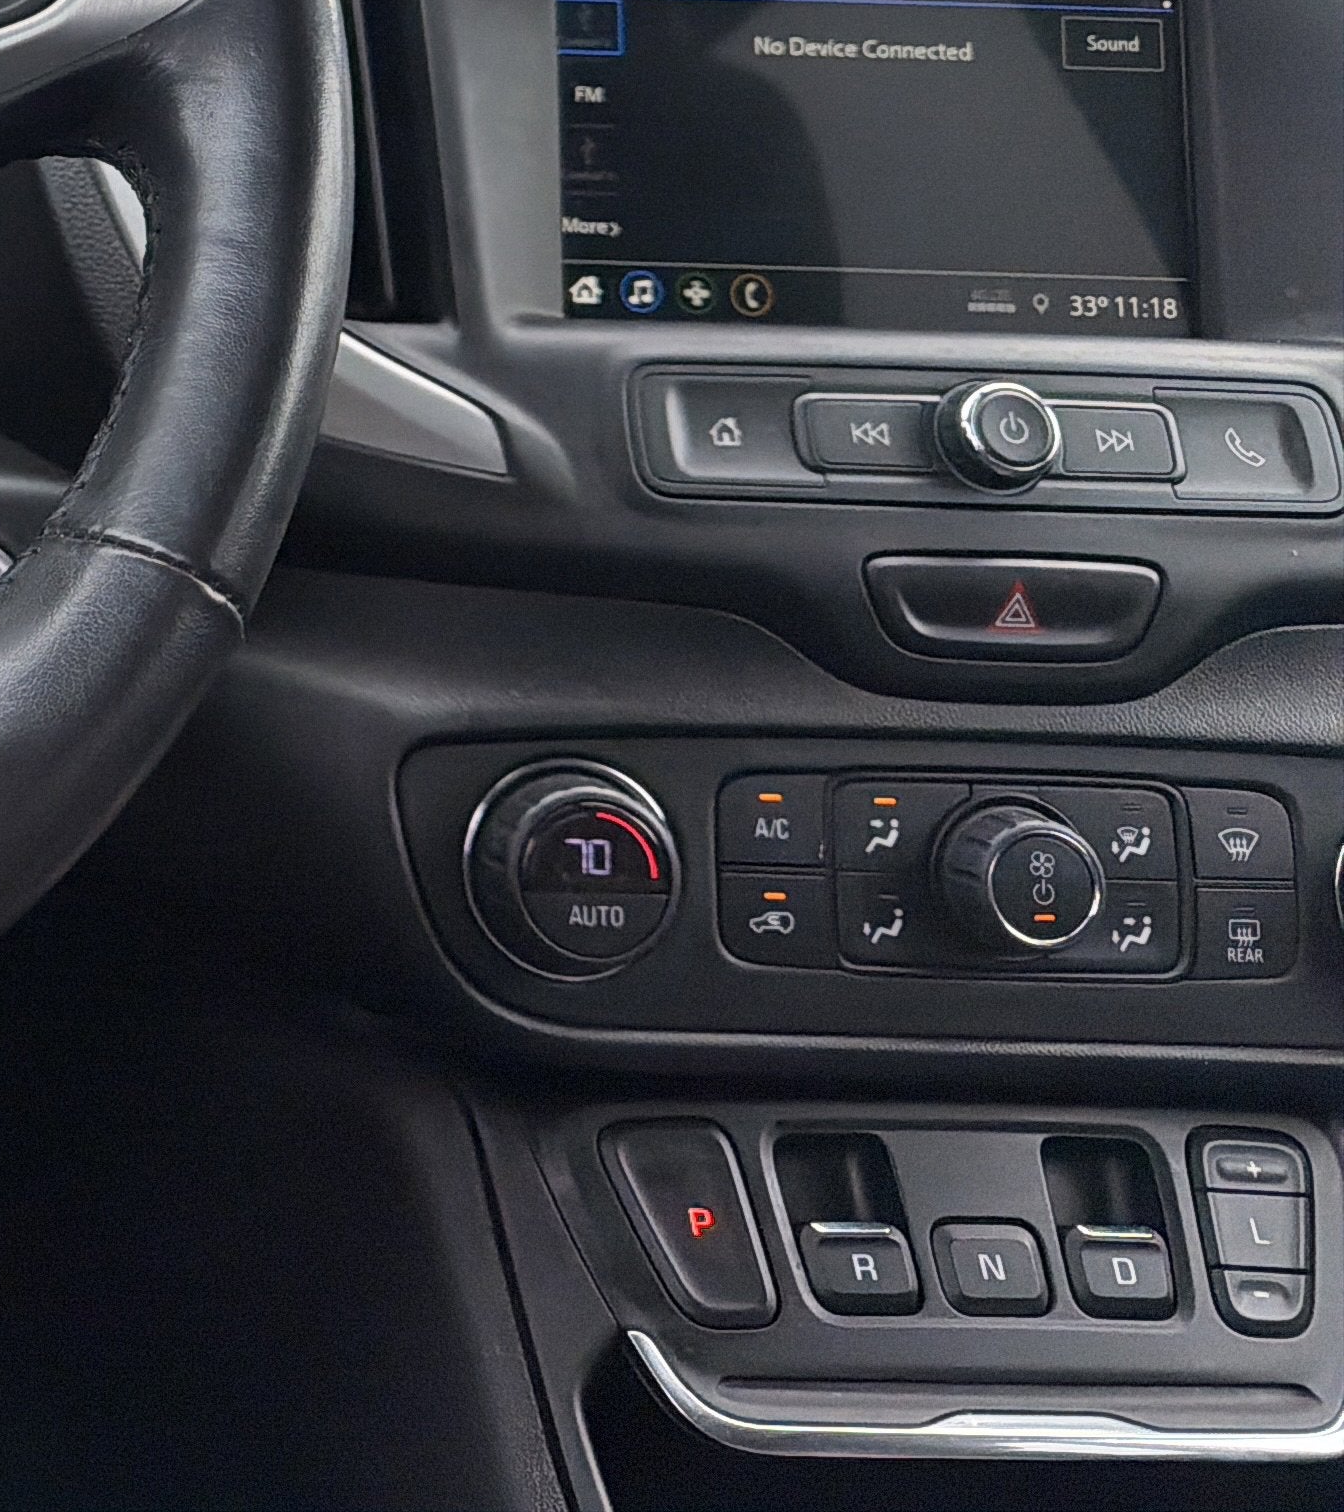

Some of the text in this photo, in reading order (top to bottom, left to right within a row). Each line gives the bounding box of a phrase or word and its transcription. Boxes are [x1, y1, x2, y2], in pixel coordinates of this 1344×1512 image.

[753, 35, 975, 63] No Device Connected
[1086, 34, 1140, 53] Sound
[574, 86, 605, 103] FM
[1115, 296, 1178, 319] 11:18
[755, 817, 790, 841] A/C
[564, 838, 611, 876] 70
[569, 904, 625, 928] AUTO
[1227, 945, 1264, 964] REAR
[689, 1208, 715, 1239] P
[1250, 1218, 1271, 1246] L
[853, 1253, 1137, 1286] R N D
